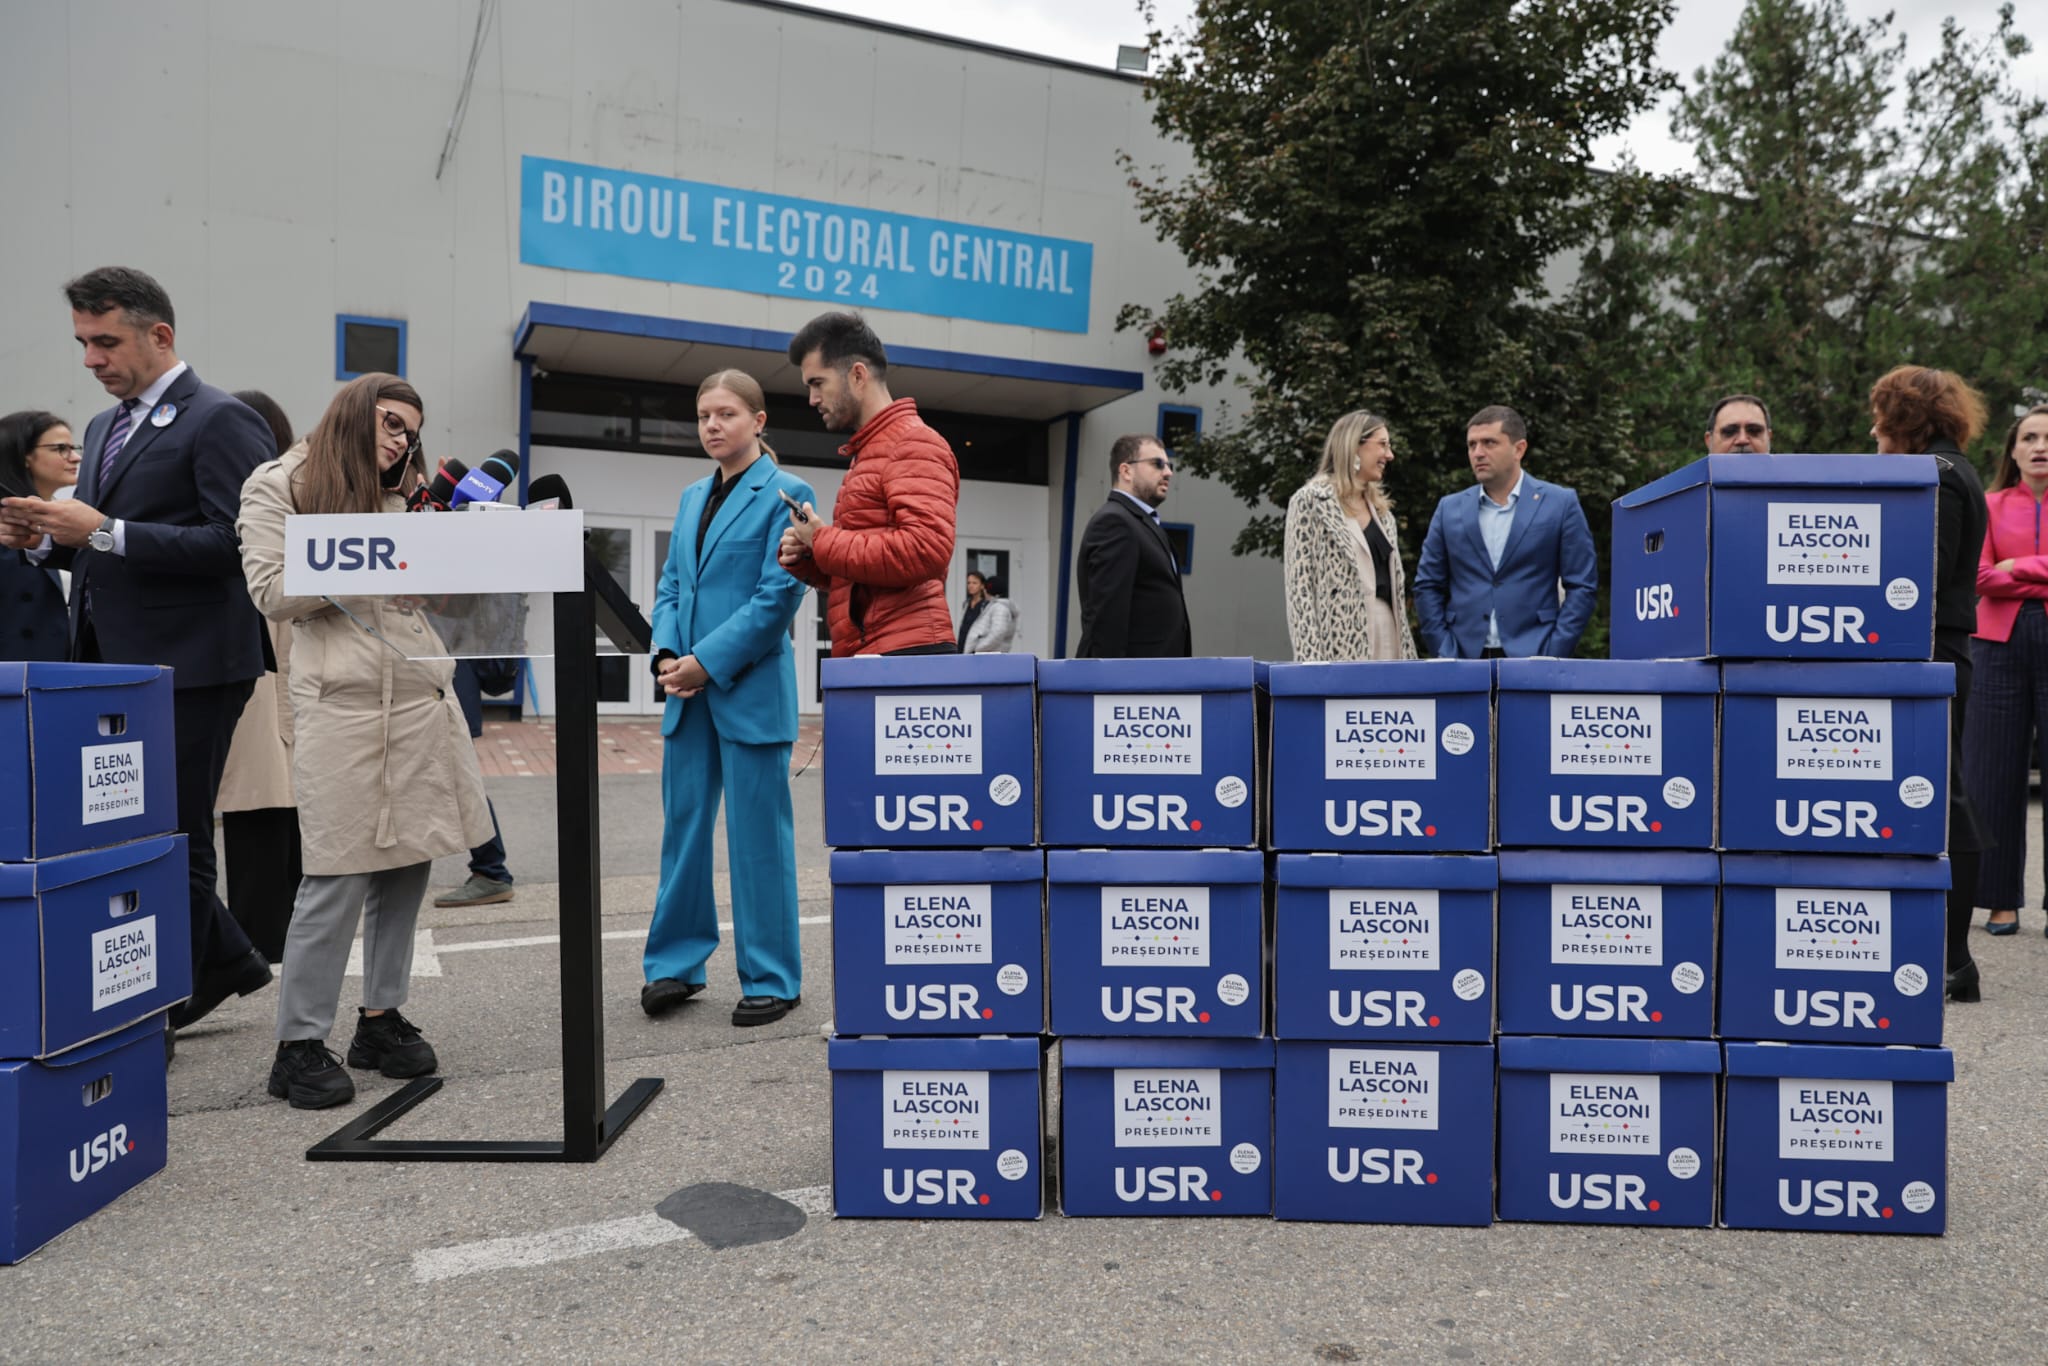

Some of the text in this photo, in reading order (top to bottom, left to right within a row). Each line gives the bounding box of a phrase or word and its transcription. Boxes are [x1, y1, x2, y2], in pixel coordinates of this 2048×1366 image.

[542, 171, 1074, 294] BIROUL ELECTORAL CENTRAL
[778, 262, 879, 300] 2024
[1789, 514, 1859, 530] ELENA
[1778, 533, 1870, 548] LASCONI
[895, 706, 961, 721] ELENA
[1114, 706, 1181, 720] ELENA
[1346, 711, 1415, 725] ELENA
[1571, 706, 1640, 720] ELENA
[1798, 709, 1869, 725] ELENA
[885, 724, 972, 739] LASCONI
[1104, 724, 1191, 738] LASCONI
[1336, 729, 1425, 743] LASCONI
[1447, 733, 1470, 741] LASCONI
[1561, 724, 1651, 739] LASCONI
[1788, 727, 1881, 743] LASCONI
[94, 753, 133, 770] ELENA
[89, 769, 138, 788] LASCONI
[1220, 781, 1237, 790] ELENA
[1220, 784, 1241, 795] LASCONI
[1668, 786, 1691, 796] LASCONI
[1672, 782, 1689, 791] ELENA
[1903, 786, 1929, 794] LASCONI
[904, 896, 971, 911] ELENA
[1121, 898, 1189, 912] ELENA
[1350, 901, 1418, 916] ELENA
[1572, 896, 1641, 911] ELENA
[1797, 900, 1869, 916] ELENA
[895, 914, 981, 929] LASCONI
[1112, 916, 1199, 930] LASCONI
[1340, 919, 1429, 934] LASCONI
[1562, 913, 1652, 929] LASCONI
[1787, 918, 1880, 935] LASCONI
[105, 930, 145, 954] ELENA
[99, 944, 151, 974] LASCONI
[1457, 974, 1474, 984] ELENA
[1677, 971, 1699, 982] LASCONI
[1681, 967, 1698, 977] ELENA
[1901, 971, 1923, 985] LASCONI
[1906, 968, 1923, 981] ELENA
[1222, 984, 1245, 992] LASCONI
[1457, 977, 1479, 989] LASCONI
[1349, 1060, 1418, 1076] ELENA
[903, 1082, 969, 1096] ELENA
[1134, 1079, 1200, 1094] ELENA
[1339, 1078, 1428, 1094] LASCONI
[1570, 1085, 1639, 1101] ELENA
[1124, 1097, 1210, 1112] LASCONI
[1800, 1089, 1871, 1106] ELENA
[893, 1099, 979, 1114] LASCONI
[1561, 1103, 1649, 1119] LASCONI
[1790, 1108, 1882, 1125] LASCONI
